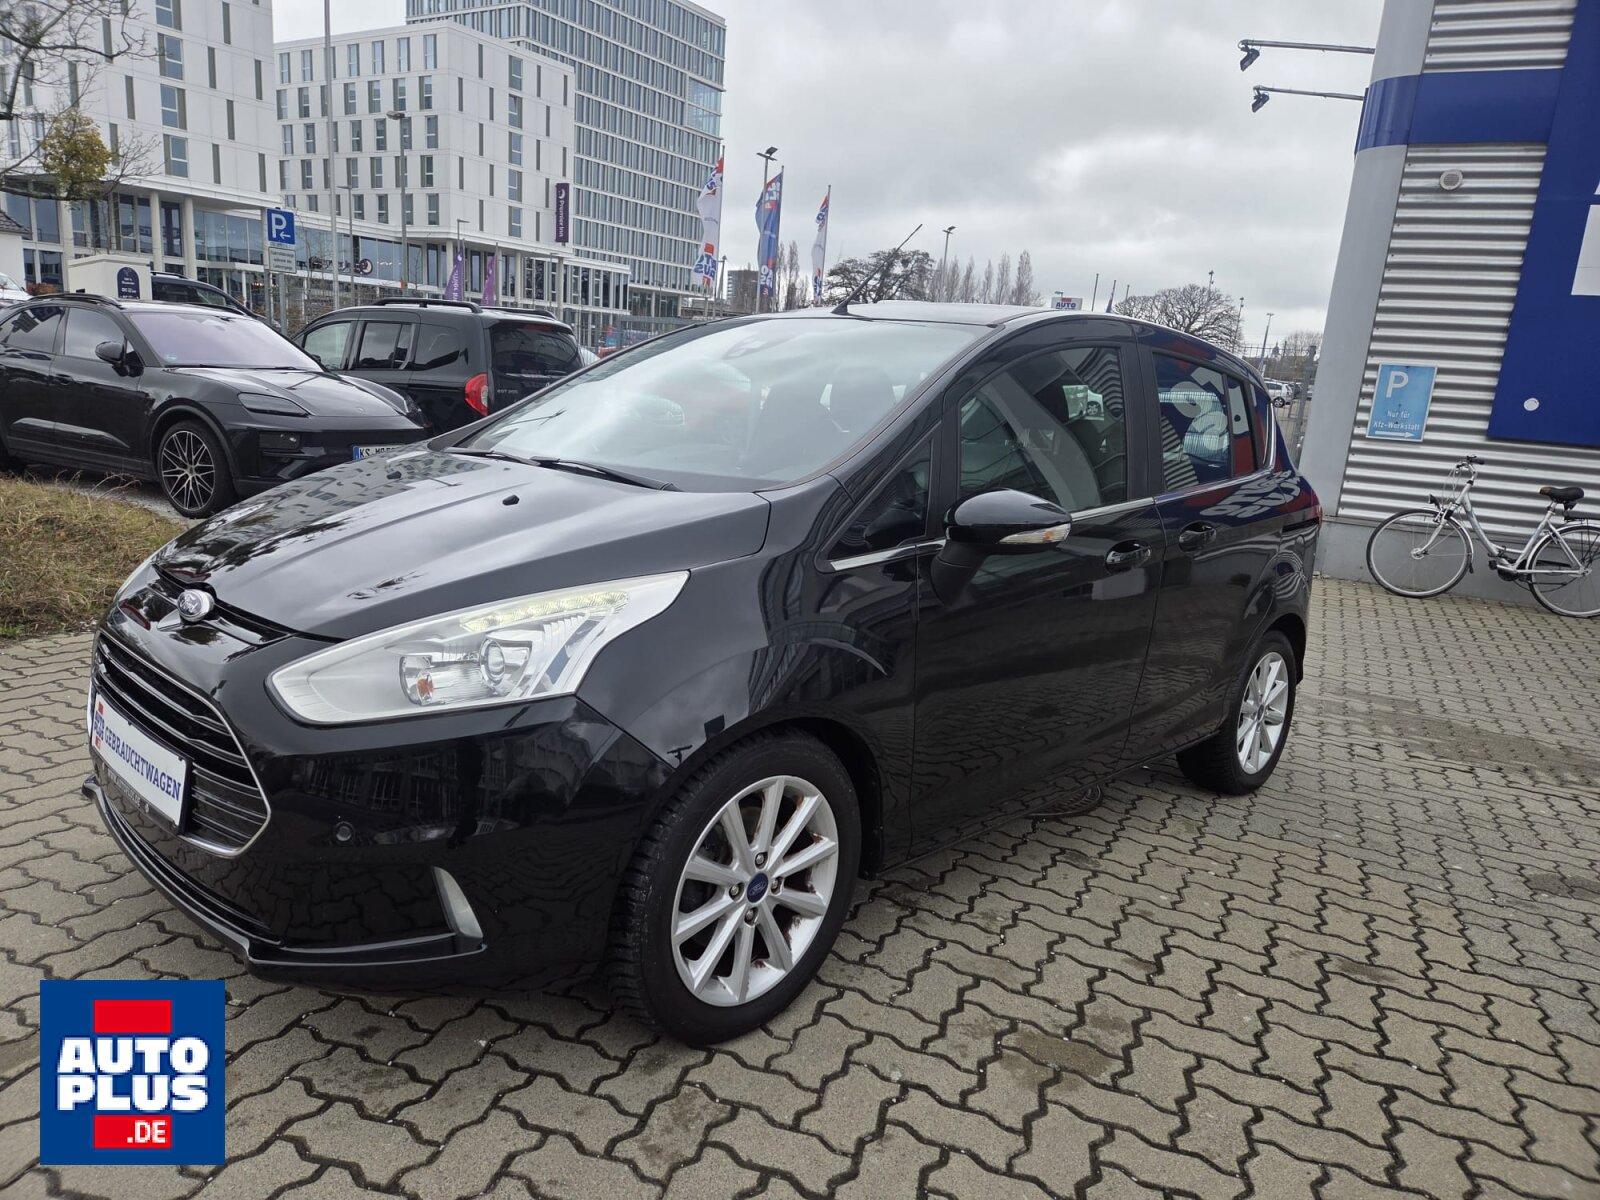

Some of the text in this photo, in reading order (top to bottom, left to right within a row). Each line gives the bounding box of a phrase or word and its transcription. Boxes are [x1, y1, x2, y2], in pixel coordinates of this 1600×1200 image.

[271, 213, 287, 239] P
[1385, 371, 1409, 398] P
[1373, 421, 1420, 430] Kfz-Werkstatt
[1386, 410, 1410, 419] Nur für
[104, 726, 182, 802] GEBRAUCHTWAGEN
